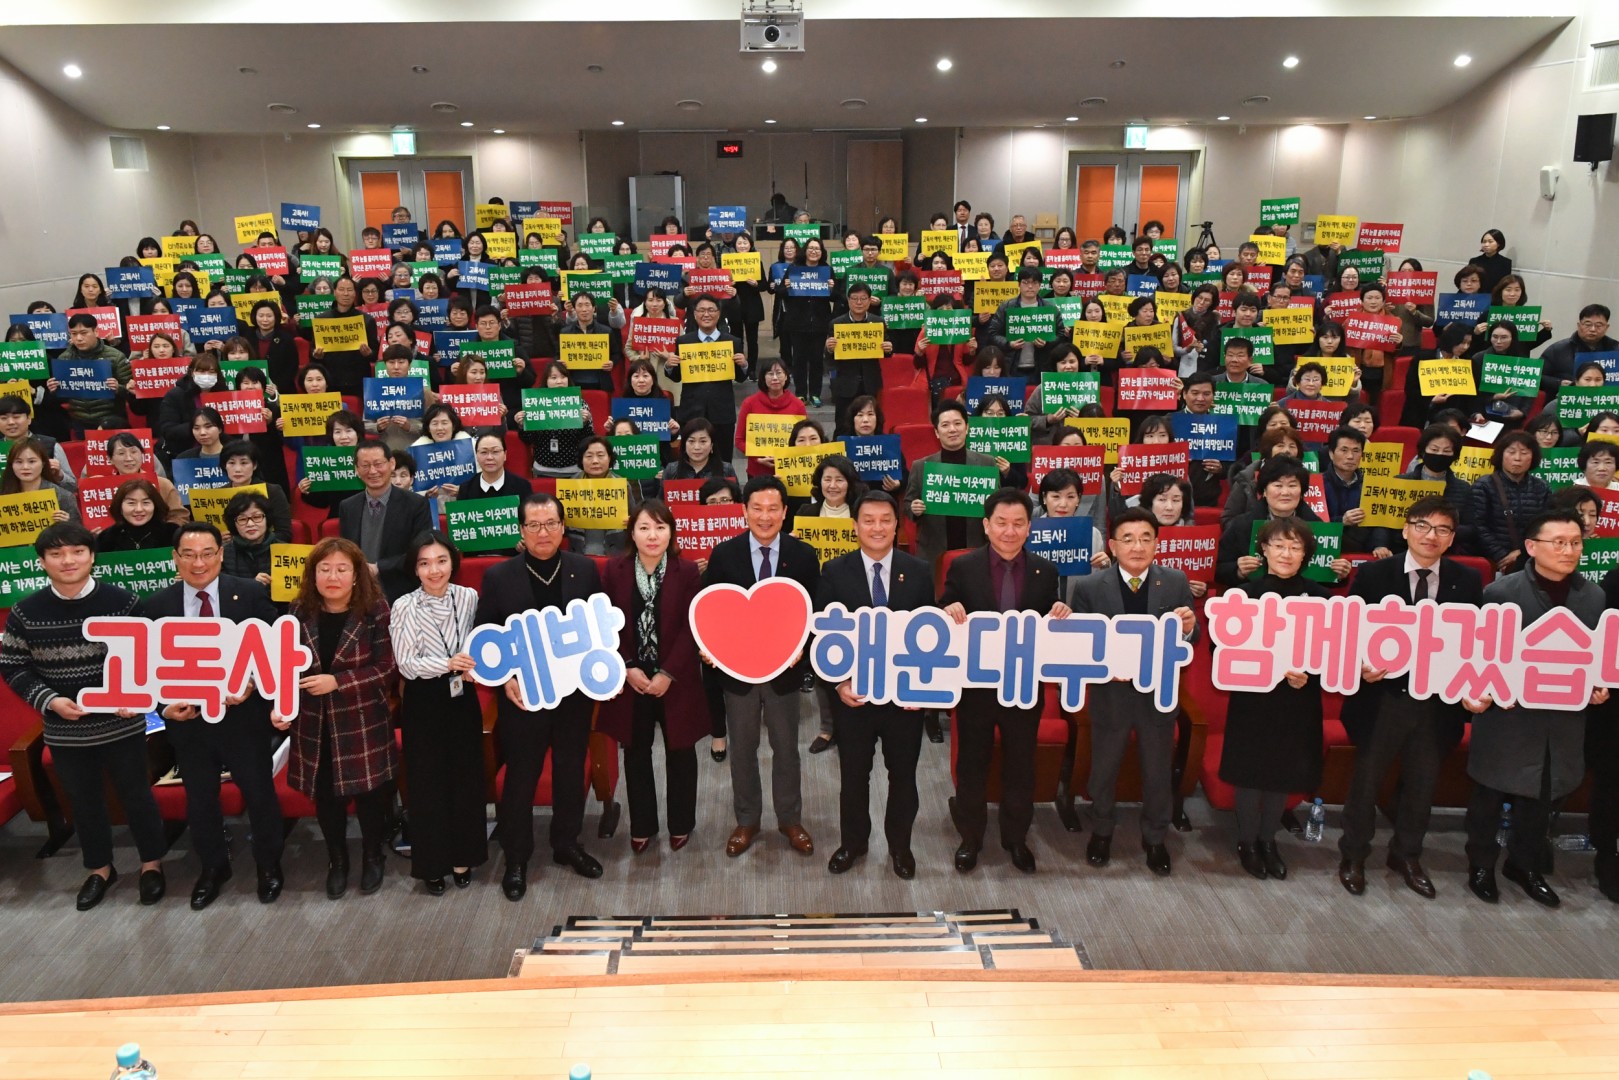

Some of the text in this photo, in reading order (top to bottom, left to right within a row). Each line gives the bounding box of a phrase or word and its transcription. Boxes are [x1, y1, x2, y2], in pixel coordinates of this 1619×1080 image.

[1485, 362, 1540, 376] 혼자 사는 이웃에게
[1044, 380, 1097, 391] 혼자 사는 이웃에게
[1121, 378, 1159, 387] 혼자 눈물 흘리지
[1485, 374, 1536, 388] 관심을 가져주세요
[382, 386, 406, 396] 고독사!
[1121, 390, 1174, 400] 당신은 혼자가 아닙니다
[367, 399, 422, 411] 이웃, 당신이 희망입니다
[525, 396, 579, 408] 혼자 사는 이웃에게
[1045, 394, 1096, 404] 관심을 가져주세요
[283, 402, 299, 413] 고독사
[316, 400, 341, 411] 해운대가
[526, 409, 579, 421] 관심을 가져주세요
[291, 417, 304, 428] 함께
[970, 426, 1028, 438] 혼자 사는 이웃에게
[1191, 424, 1216, 434] 고독사!
[970, 441, 1027, 452] 관심을 가져주세요
[1188, 439, 1233, 450] 당신이 희망입니다
[428, 449, 454, 463] 고독사!
[429, 467, 444, 480] 당신이
[446, 464, 473, 478] 희망입니다
[927, 473, 995, 489] 혼자 사는 이웃에게
[559, 490, 578, 501] 고독사
[597, 490, 625, 500] 해운대가
[926, 491, 950, 504] 관심을
[1364, 486, 1388, 497] 고독사
[450, 506, 518, 524] 혼자 사는 이웃에게
[567, 507, 617, 518] 함께 하겠습니다
[1371, 504, 1387, 515] 함께
[676, 516, 728, 531] 혼자 눈물 흘리지
[453, 524, 519, 541] 관심을 가져주세요
[676, 536, 698, 550] 당신은
[470, 597, 620, 706] 예방
[1210, 593, 1619, 706] 함께하겠습
[814, 608, 1189, 708] 해운대구가
[81, 620, 307, 718] 고독사
